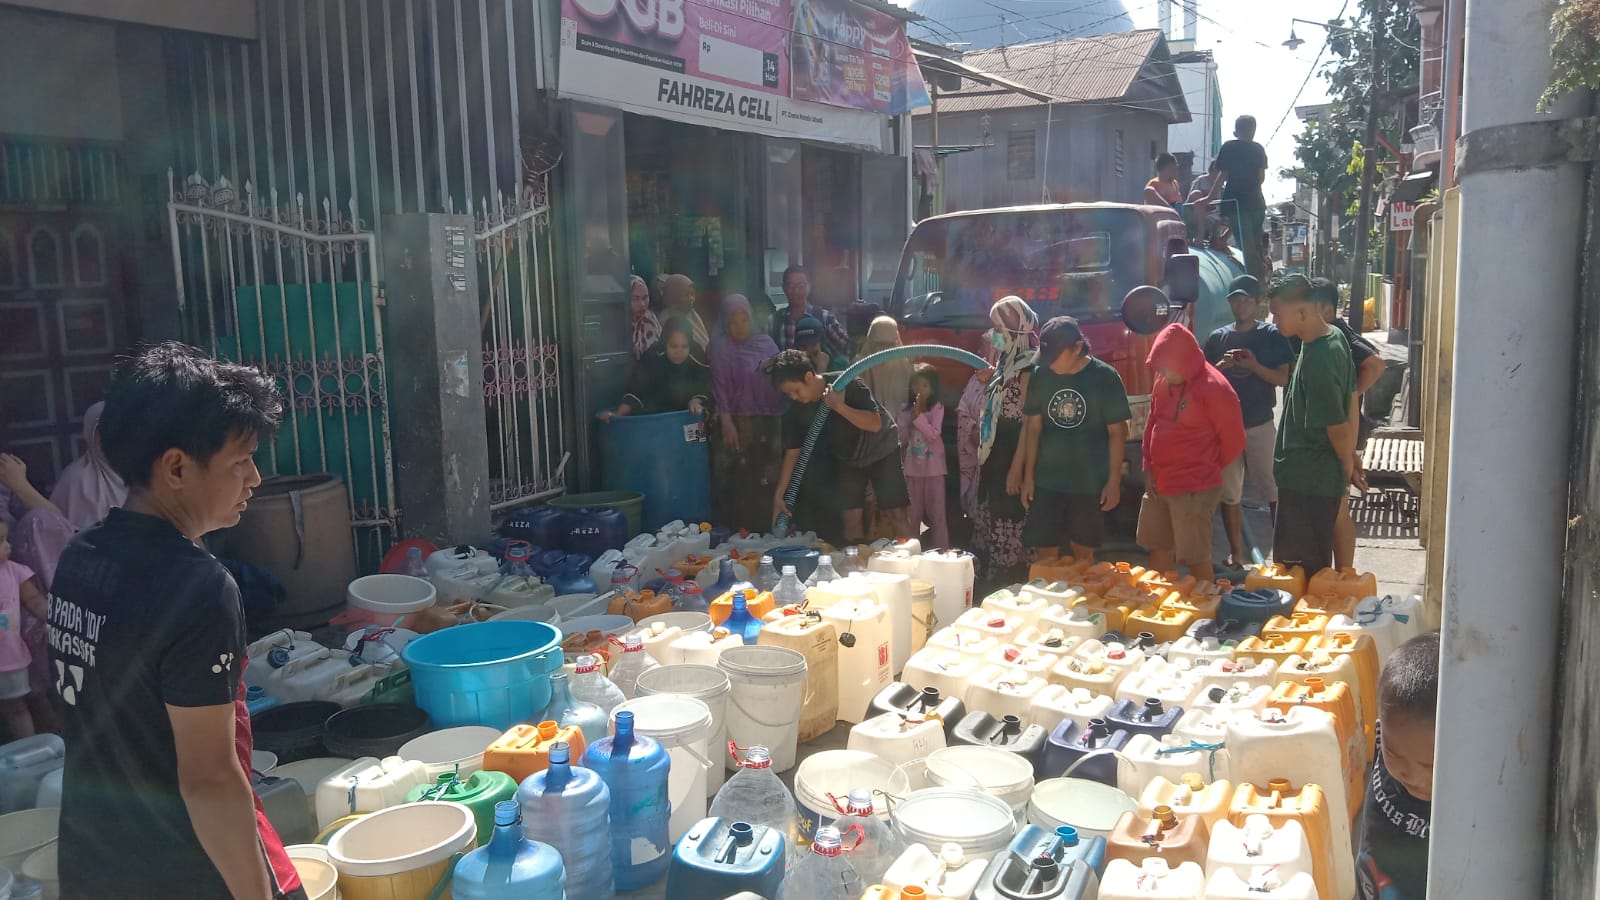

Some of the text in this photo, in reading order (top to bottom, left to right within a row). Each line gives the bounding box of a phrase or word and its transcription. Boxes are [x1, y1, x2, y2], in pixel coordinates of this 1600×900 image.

[740, 0, 772, 21] Pilihan
[699, 16, 713, 31] Beli
[702, 41, 712, 54] Rp
[766, 59, 776, 73] 14
[657, 77, 773, 122] FAHREZA CELL
[54, 597, 82, 633] PADA
